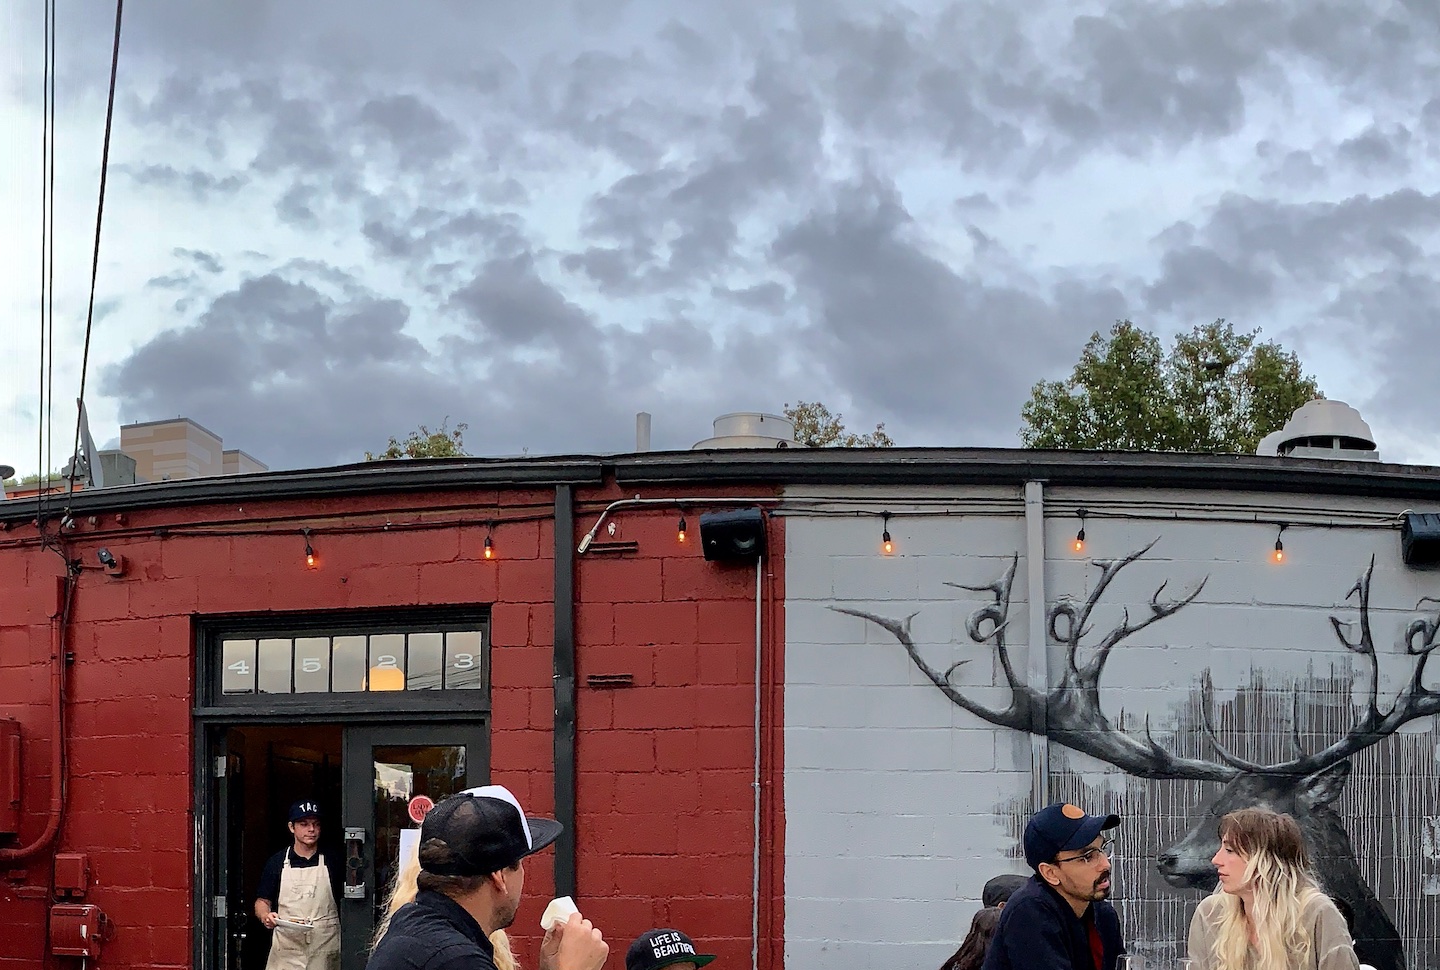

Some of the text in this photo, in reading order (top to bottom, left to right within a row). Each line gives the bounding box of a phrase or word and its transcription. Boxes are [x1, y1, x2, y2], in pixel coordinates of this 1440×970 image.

[228, 660, 249, 675] 4
[302, 658, 321, 672] 5
[454, 653, 474, 668] 3
[649, 932, 681, 948] LIFE IS
